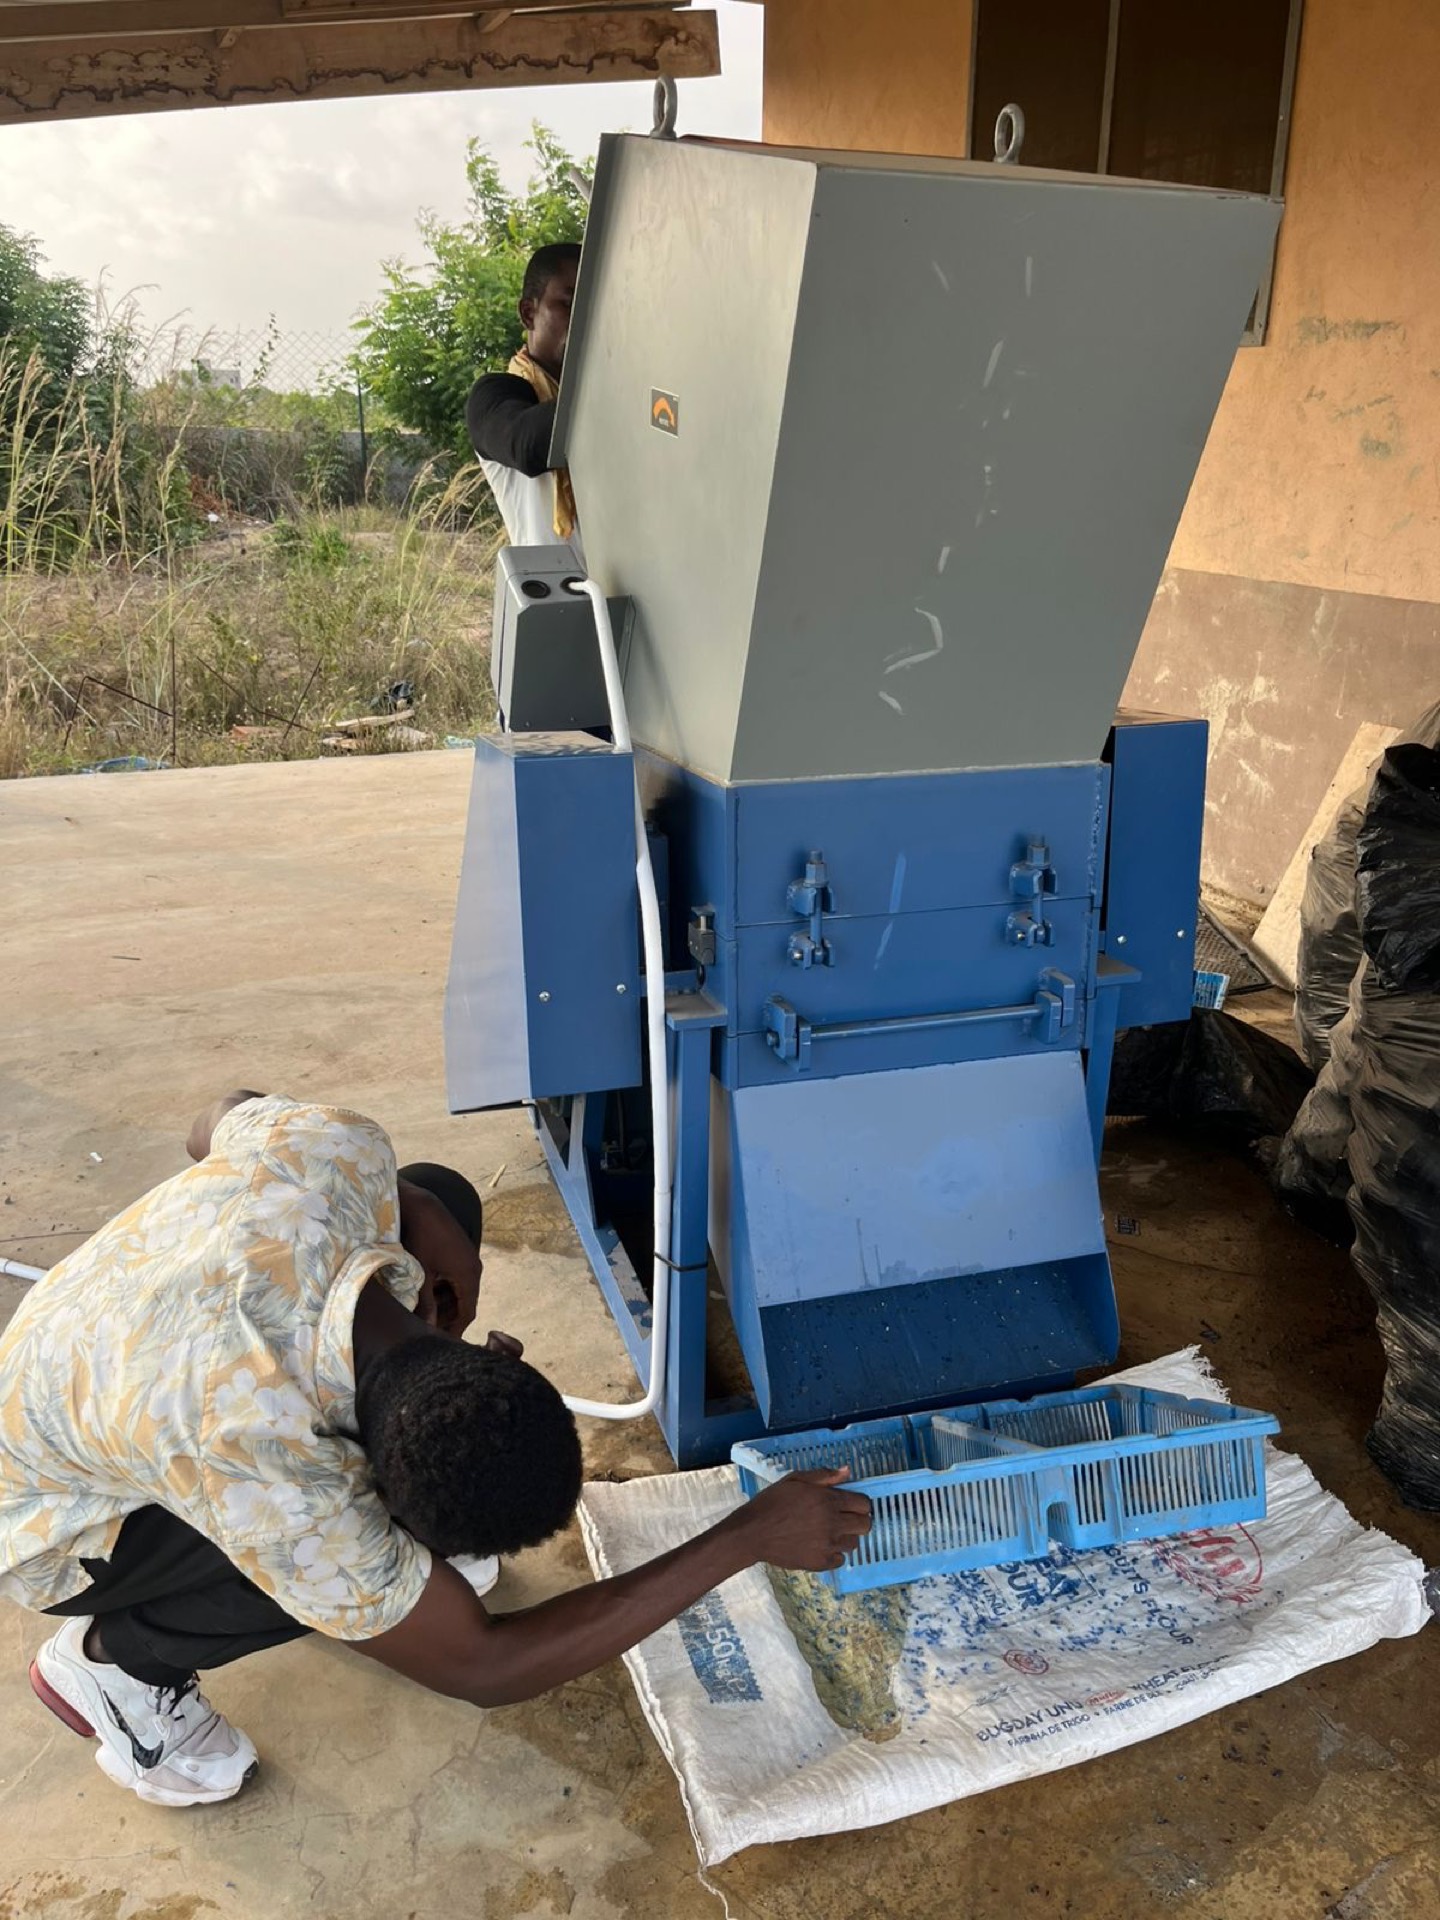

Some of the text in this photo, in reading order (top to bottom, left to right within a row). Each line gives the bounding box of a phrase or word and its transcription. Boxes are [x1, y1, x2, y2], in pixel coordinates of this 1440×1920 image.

[996, 1561, 1044, 1610] OUR
[1142, 1598, 1194, 1645] FLOUR
[1045, 1701, 1083, 1717] UNU
[1127, 1669, 1179, 1692] WHEAT
[1008, 1730, 1049, 1746] FARINHA
[1047, 1723, 1062, 1735] DE
[1060, 1713, 1090, 1729] TRIGO
